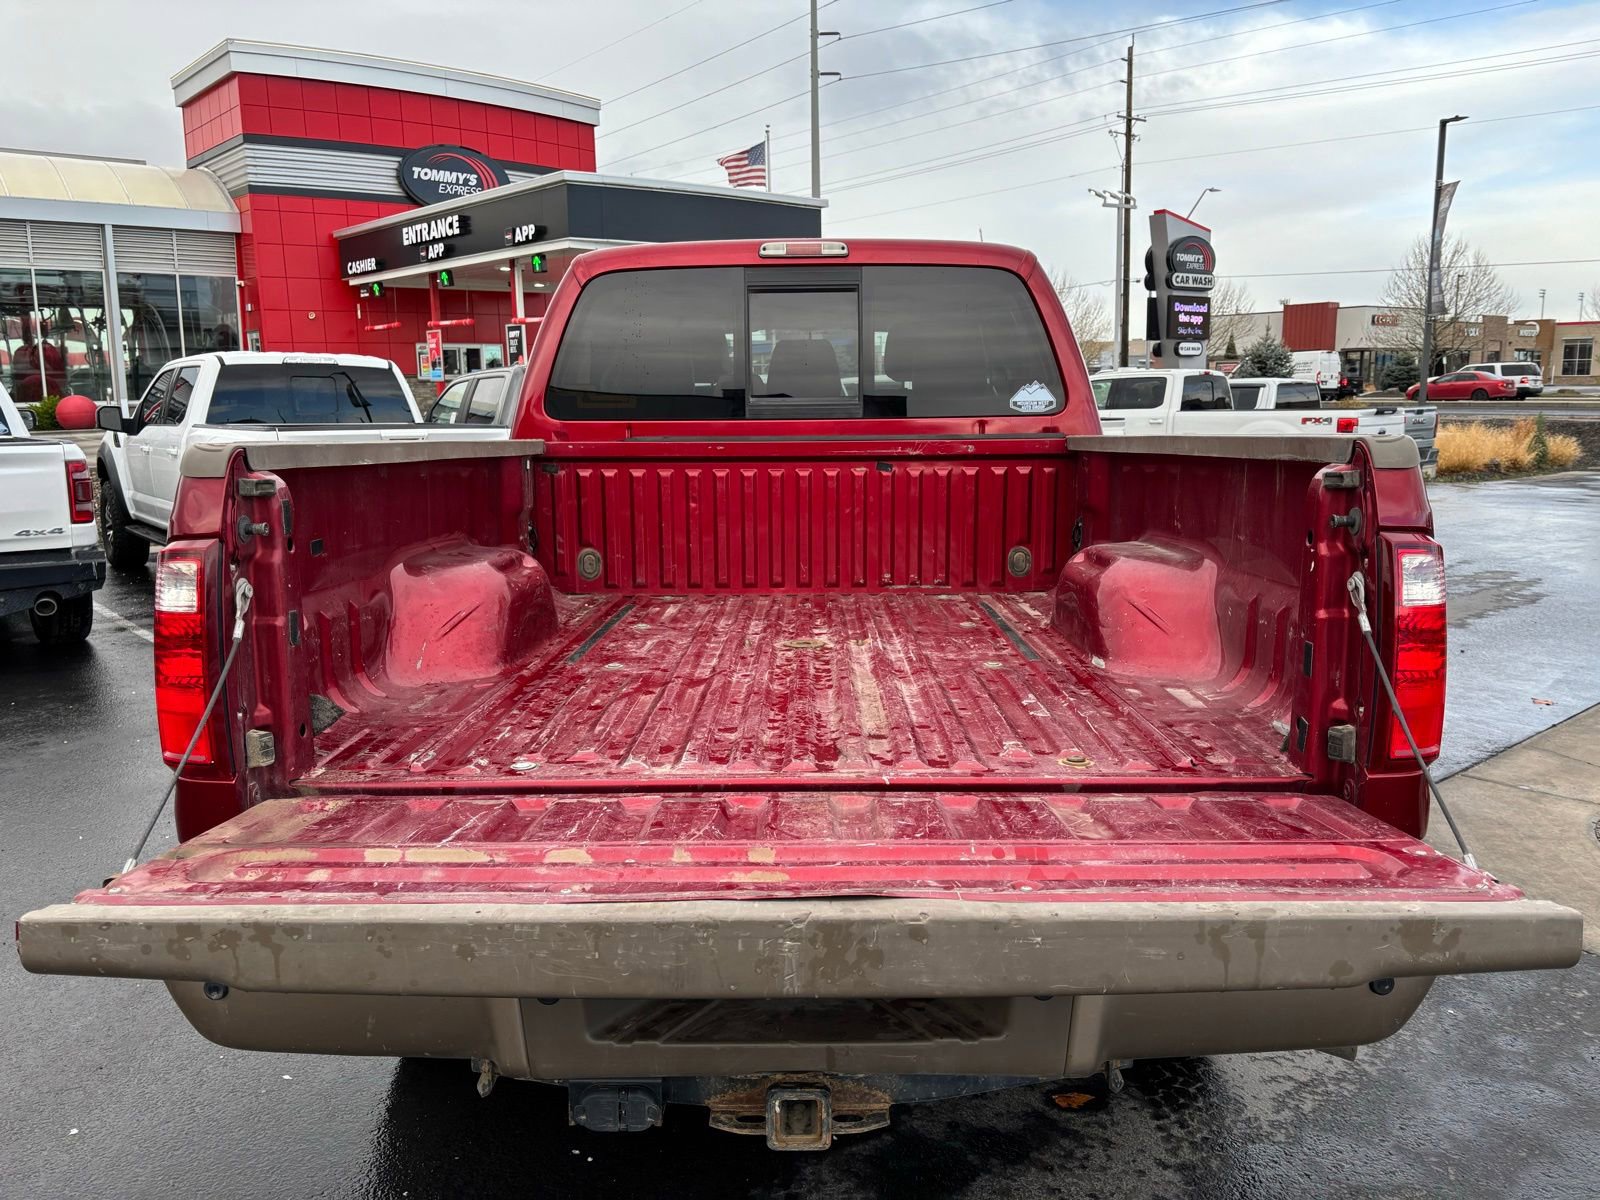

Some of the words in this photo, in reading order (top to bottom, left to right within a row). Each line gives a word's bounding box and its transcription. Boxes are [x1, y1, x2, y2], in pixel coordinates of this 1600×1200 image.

[412, 166, 478, 186] TOMMY'S
[438, 183, 482, 197] EXPRESS
[402, 214, 461, 246] ENTRANCE
[514, 224, 536, 243] APP
[428, 243, 445, 260] APP
[1176, 253, 1204, 263] TOMMY'S
[347, 257, 376, 274] CASHIER
[1175, 275, 1190, 285] CAR
[1191, 275, 1213, 287] WASH
[1174, 302, 1208, 313] Download
[1178, 312, 1190, 323] the
[1190, 315, 1204, 325] app
[1301, 417, 1332, 425] FX4
[14, 527, 66, 537] 4x4
